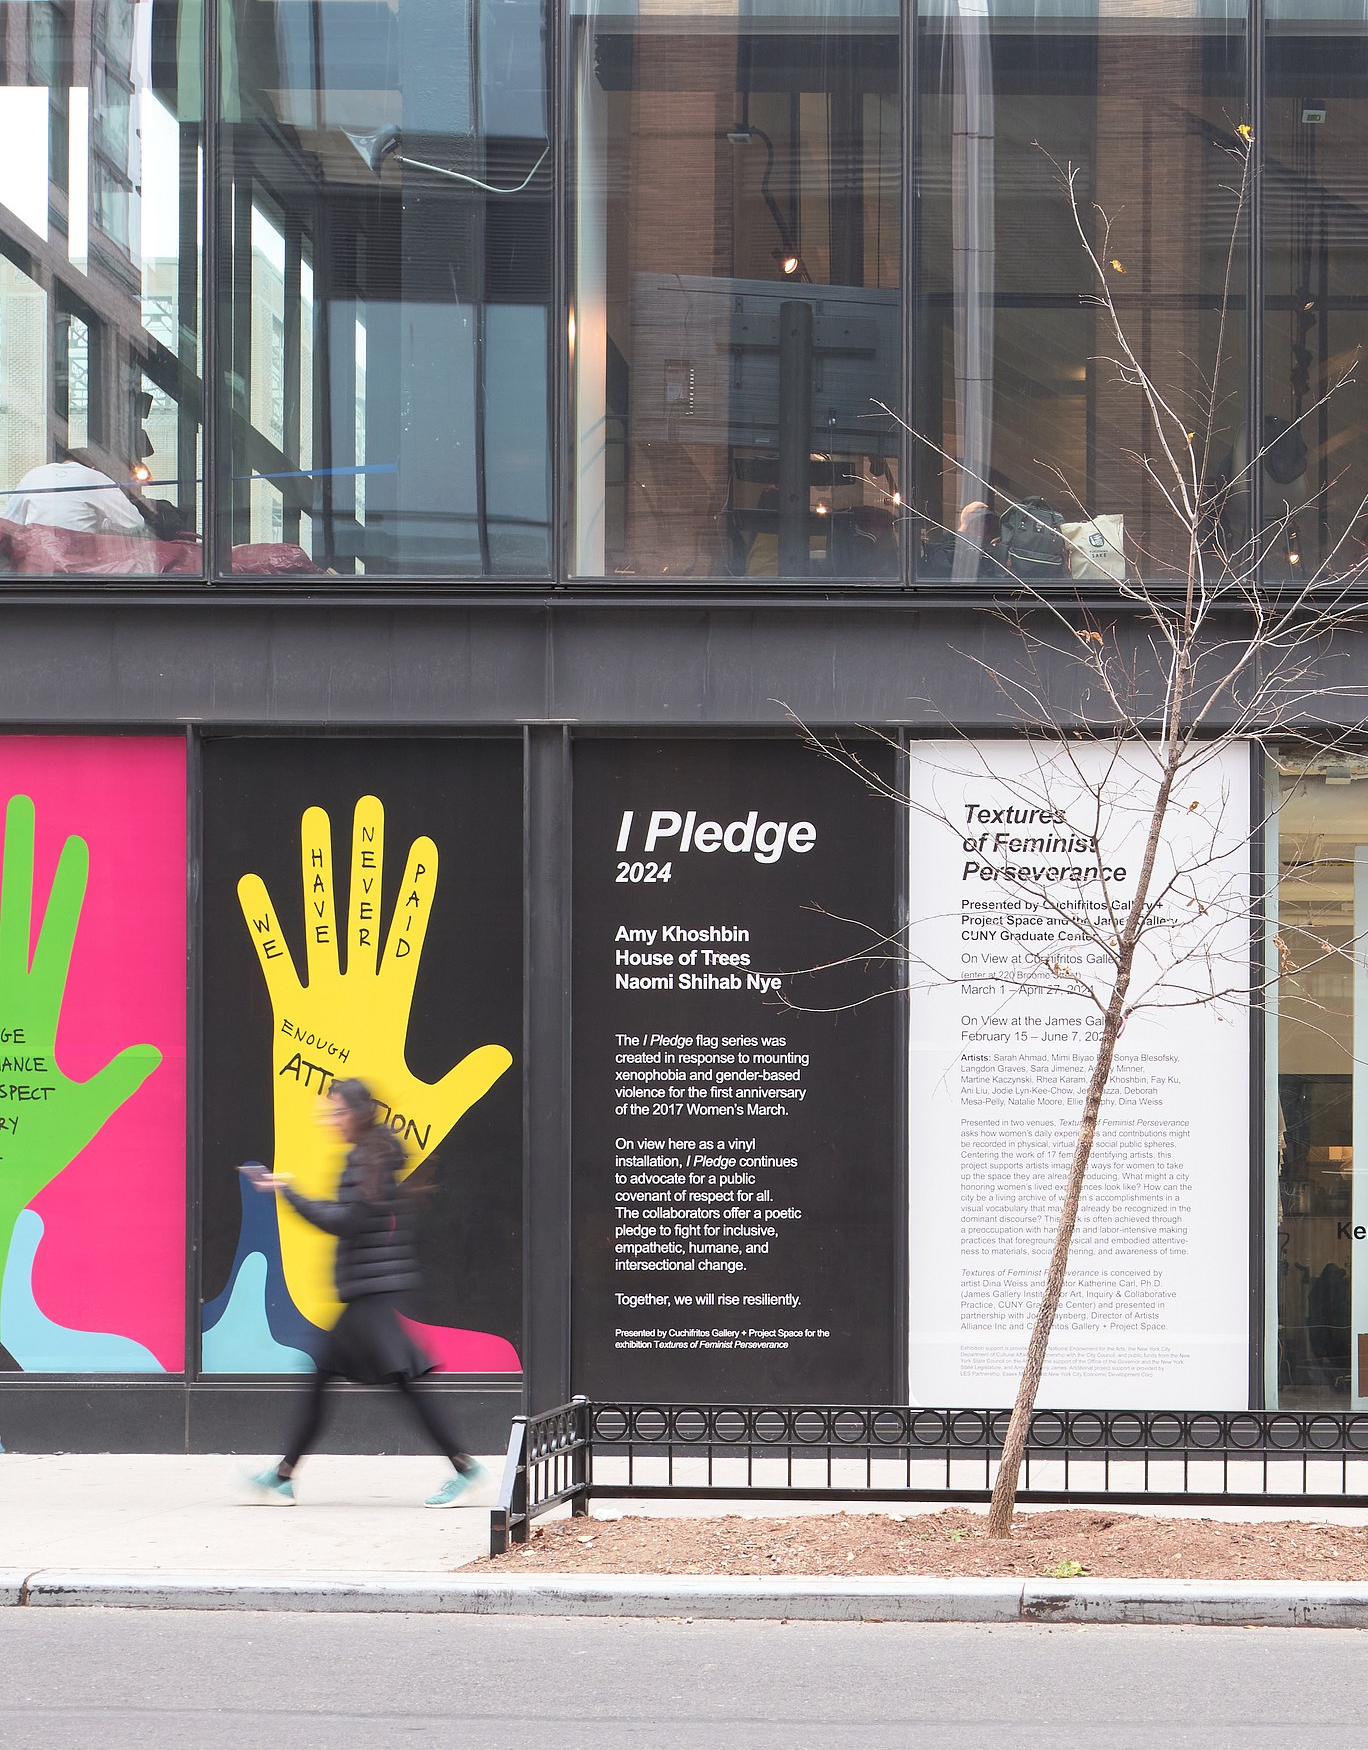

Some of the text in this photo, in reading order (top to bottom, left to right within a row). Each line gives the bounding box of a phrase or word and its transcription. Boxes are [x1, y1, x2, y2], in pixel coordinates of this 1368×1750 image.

[964, 804, 1067, 824] Textures
[615, 810, 818, 864] I Pledge
[962, 832, 1097, 853] of Feminist
[614, 861, 673, 883] 2024
[962, 861, 1127, 882] Perseverance
[359, 826, 377, 947] NEVER
[311, 848, 330, 944] HAVE
[395, 863, 426, 958] PAID
[961, 899, 1021, 910] Presented
[1025, 899, 1040, 912] by
[961, 915, 1003, 928] Project
[1006, 915, 1043, 928] Space
[1046, 915, 1069, 926] and
[252, 913, 284, 959] WE
[614, 925, 750, 946] Amy Khoshbin
[961, 930, 997, 941] CUNY
[1000, 930, 1055, 941] Graduate
[615, 949, 751, 966] House of Trees
[961, 952, 1022, 964] On View at
[997, 970, 1014, 980] 220
[615, 973, 783, 994] Naomi Shihab Nye
[961, 985, 996, 995] March
[1018, 985, 1044, 997] April
[961, 1015, 1082, 1026] On View at the James
[281, 1019, 351, 1063] ENOUGH
[614, 1033, 787, 1050] The I Pledge flag series was
[961, 1031, 1011, 1043] February
[1014, 1031, 1028, 1042] 15
[1040, 1031, 1069, 1042] June
[1071, 1031, 1082, 1043] 7,
[0, 1056, 48, 1072] ANCE
[615, 1051, 810, 1067] created in response to mounting
[961, 1053, 991, 1062] Artists:
[993, 1053, 1018, 1062] Sarah
[1051, 1053, 1071, 1062] Mimi
[1113, 1053, 1139, 1063] Sonya
[614, 1068, 801, 1084] xenophobia and gender-based
[961, 1064, 996, 1075] Langdon
[1030, 1064, 1049, 1073] Sara
[614, 1085, 807, 1102] violence for the first anniversary
[614, 1102, 629, 1116] of
[629, 1102, 650, 1116] the
[652, 1102, 684, 1116] 2017
[746, 1102, 789, 1116] March.
[614, 1137, 756, 1153] On view here as a vinyl
[615, 1154, 799, 1170] installation, I Pledge continues
[614, 1171, 756, 1188] to advocate for a public
[614, 1189, 774, 1205] covenant of respect for all.
[614, 1206, 803, 1222] The collaborators offer a poetic
[615, 1258, 747, 1274] intersectional change.
[614, 1292, 802, 1309] Together, we will rise resiliently.
[614, 1328, 656, 1338] Presented
[656, 1328, 668, 1339] by
[668, 1328, 711, 1338] Cuchifritos
[711, 1328, 741, 1339] Gallery
[748, 1328, 777, 1340] Project
[777, 1328, 804, 1339] Space
[804, 1328, 817, 1338] for
[816, 1328, 831, 1338] the
[614, 1339, 790, 1349] exhibition Textures of Feminist Perseverance
